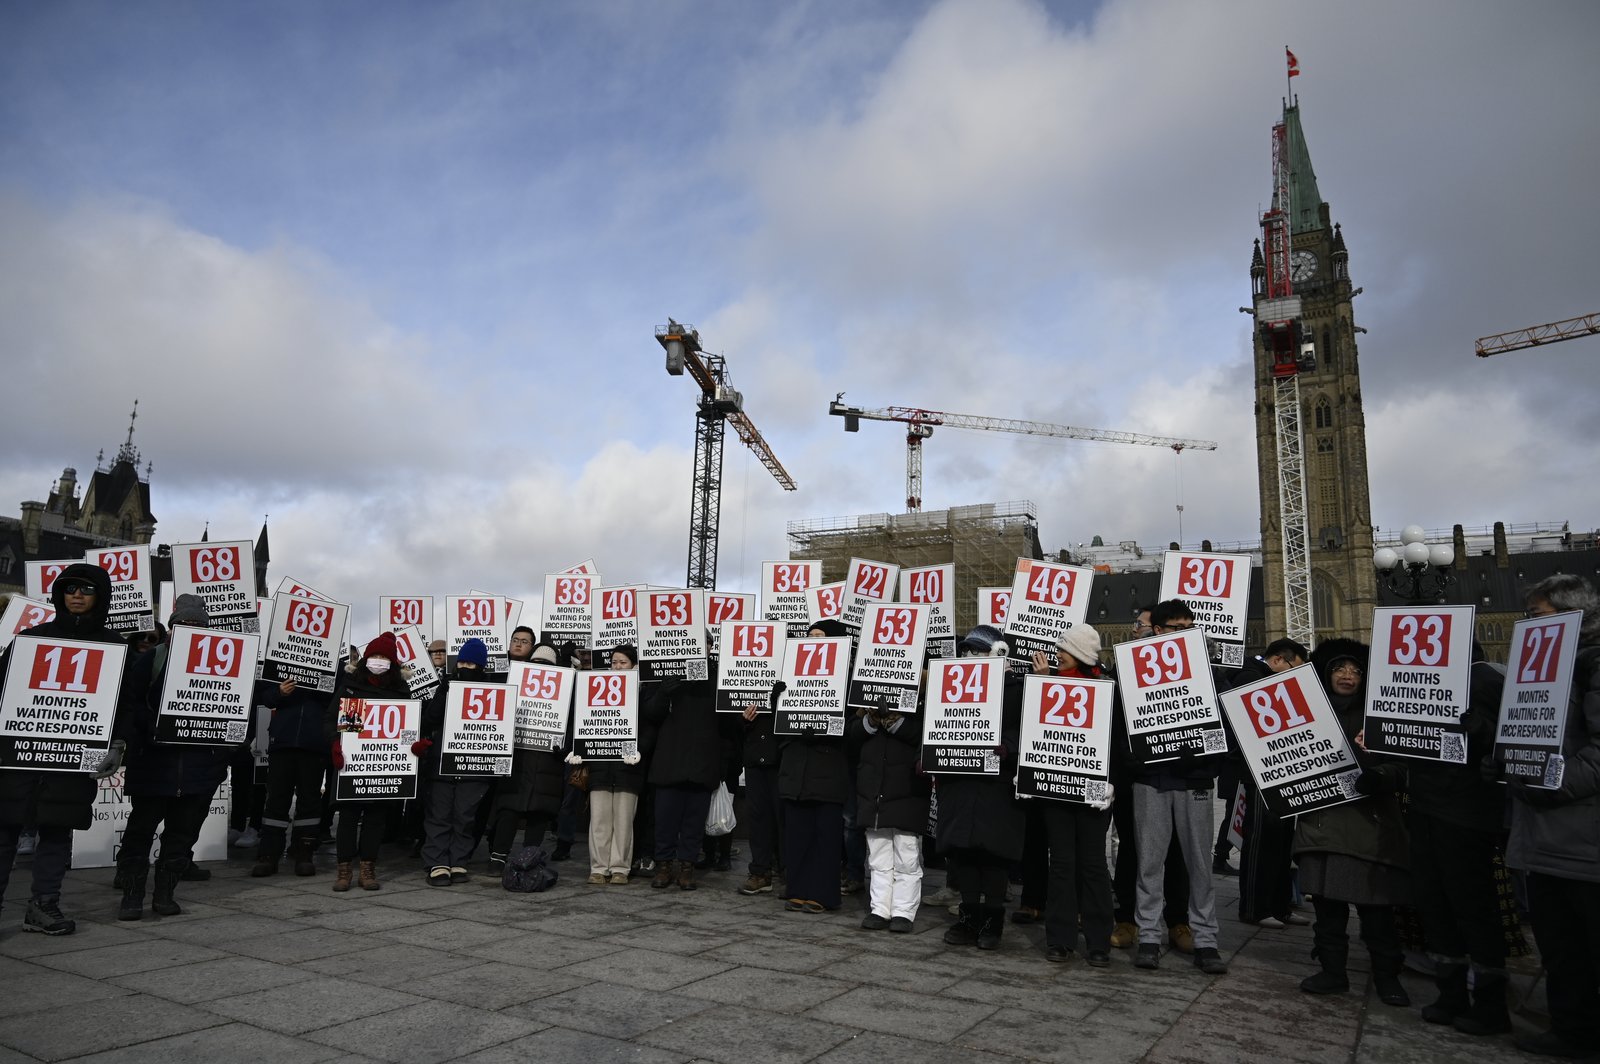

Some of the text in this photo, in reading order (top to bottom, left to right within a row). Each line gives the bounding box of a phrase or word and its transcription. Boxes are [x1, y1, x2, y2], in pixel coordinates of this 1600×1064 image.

[104, 552, 134, 582] 29
[196, 548, 235, 581] 68
[777, 566, 806, 591] 34
[857, 565, 883, 597] 22
[1031, 568, 1070, 604] 46
[1184, 559, 1227, 597] 30
[196, 584, 235, 594] MONTHS
[559, 579, 586, 604] 38
[914, 571, 939, 602] 40
[394, 600, 419, 624] 30
[606, 590, 633, 618] 40
[656, 594, 687, 626] 53
[714, 598, 739, 624] 72
[1028, 605, 1064, 618] MONTHS
[292, 602, 327, 636] 68
[462, 600, 491, 626] 30
[606, 621, 633, 629] MONTHS
[878, 609, 912, 646] 53
[288, 635, 322, 648] MONTHS
[655, 630, 688, 638] MONTHS
[738, 626, 770, 657] 15
[1395, 616, 1443, 665] 33
[278, 642, 329, 658] WAITING FOR
[647, 639, 680, 647] WAITING
[194, 636, 235, 676] 19
[271, 650, 332, 668] IRCC RESPONSE
[661, 648, 701, 656] RESPONSE
[802, 643, 829, 675] 71
[874, 648, 906, 658] MONTHS
[1522, 625, 1560, 682] 27
[39, 647, 88, 692] 11
[864, 658, 912, 669] WAITING FOR
[1139, 640, 1183, 685] 39
[858, 668, 916, 680] IRCC RESPONSE
[1392, 672, 1440, 685] MONTHS
[189, 679, 231, 691] MONTHS
[525, 670, 557, 699] 55
[592, 676, 622, 706] 28
[946, 664, 983, 702] 34
[32, 695, 87, 708] MONTHS
[177, 690, 240, 703] WAITING FOR
[1145, 686, 1189, 702] MONTHS
[1380, 686, 1452, 701] WAITING FOR
[1517, 690, 1549, 703] MONTHS
[167, 701, 244, 714] IRCC RESPONSE
[468, 689, 498, 722] 51
[521, 700, 552, 710] MONTHS
[782, 699, 840, 708] IRCC RESPONSE
[1045, 684, 1088, 726] 23
[1136, 696, 1203, 716] WAITING FOR
[1251, 682, 1306, 734] 81
[1372, 700, 1459, 718] IRCC RESPONSE
[17, 707, 98, 722] WAITING FOR
[798, 714, 831, 722] TIMELINES
[944, 708, 980, 717] MONTHS
[1133, 707, 1212, 729] IRCC RESPONSE
[1508, 707, 1555, 720] WAITING FOR
[5, 720, 104, 736] IRCC RESPONSE
[363, 705, 402, 739] 40
[463, 724, 497, 732] MONTHS
[934, 720, 990, 729] WAITING FOR
[1382, 722, 1446, 738] NO TIMELINES
[177, 729, 227, 740] NO RESULTS
[454, 733, 487, 741] WAITING
[928, 732, 994, 741] IRCC RESPONSE
[1044, 730, 1086, 743] MONTHS
[1146, 728, 1204, 744] NO TIMELINES
[1500, 724, 1558, 738] IRCC RESPONSE
[14, 740, 87, 754] NO TIMELINES
[466, 742, 508, 751] RESPONSE
[1032, 741, 1096, 757] WAITING FOR
[1267, 730, 1314, 752] MONTHS
[1385, 735, 1441, 752] NO RESULTS
[17, 752, 81, 764] NO RESULTS
[351, 754, 388, 762] WAITING
[947, 749, 984, 757] TIMELINES
[1025, 752, 1102, 770] IRCC RESPONSE
[1261, 739, 1334, 768] WAITING FOR
[1504, 749, 1546, 762] NO TIMELINES
[344, 764, 412, 772] IRCC RESPONSE
[950, 758, 980, 767] RESULTS
[1260, 750, 1347, 783] IRCC RESPONSE
[1505, 763, 1542, 776] NO RESULTS
[1036, 782, 1086, 797] NO RESULTS
[1288, 785, 1343, 807] NO RESULTS
